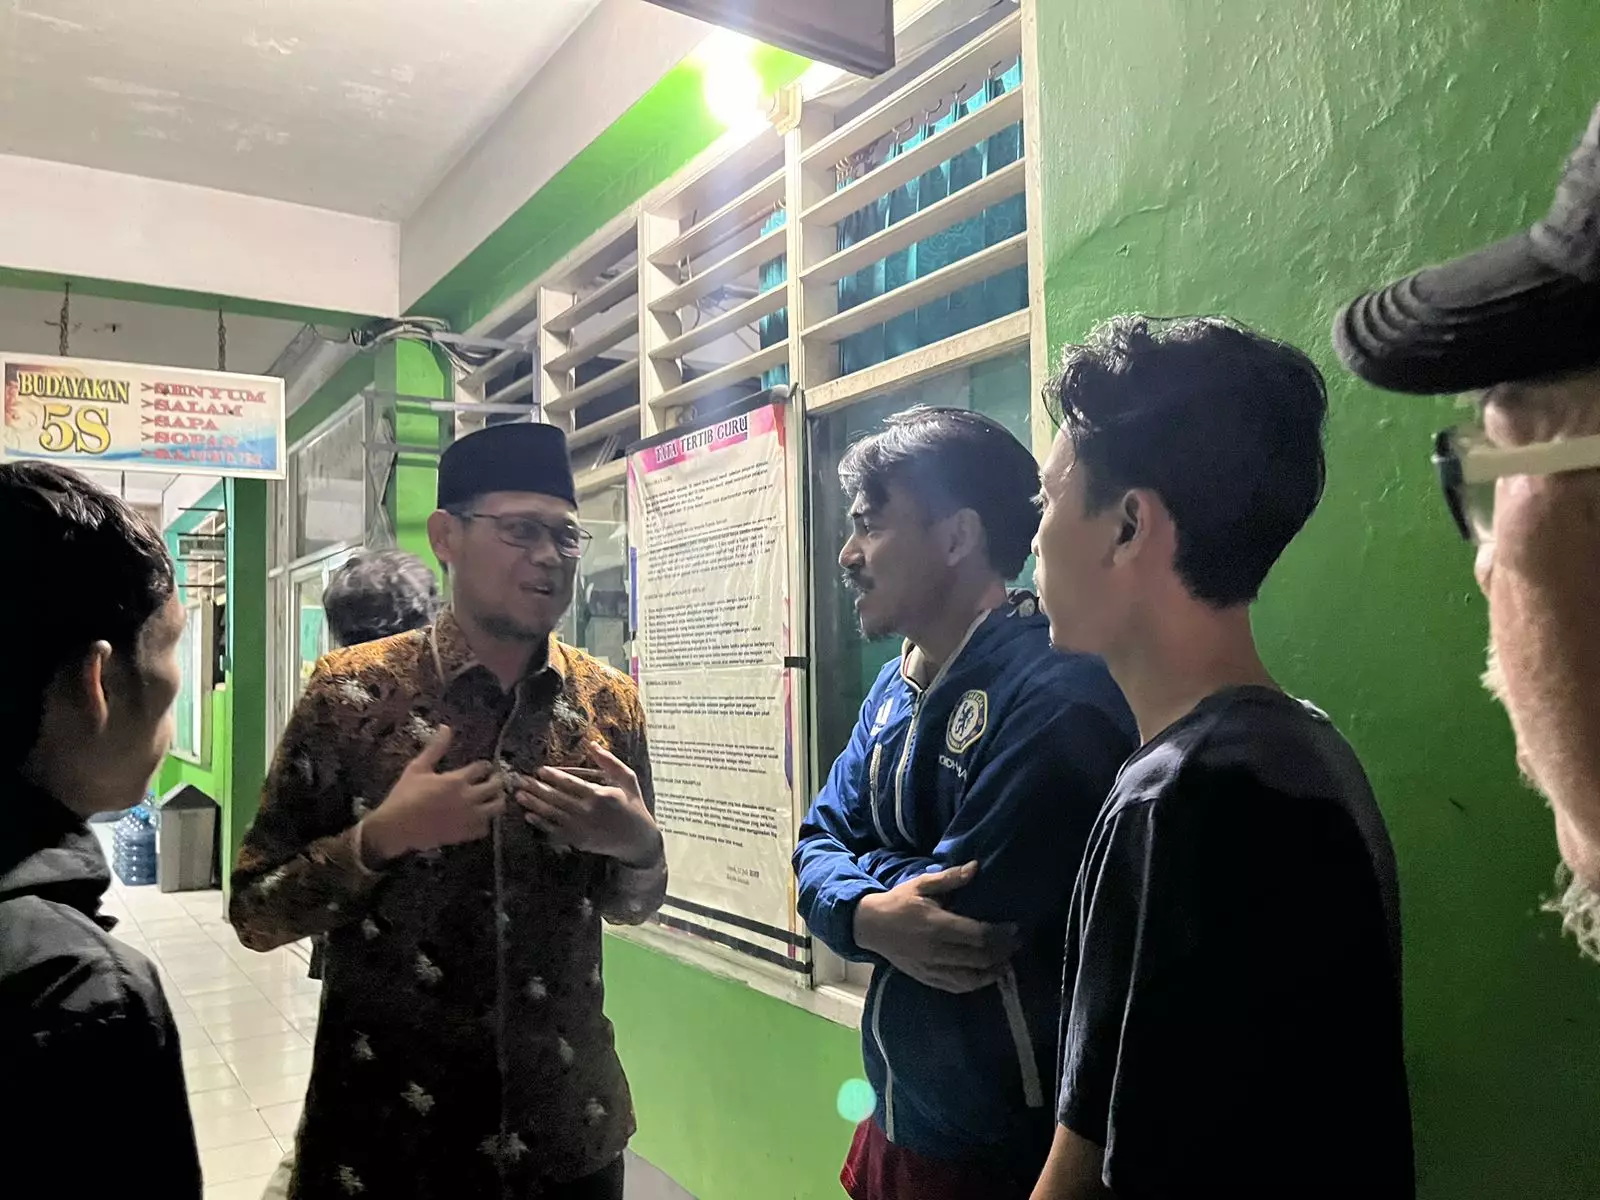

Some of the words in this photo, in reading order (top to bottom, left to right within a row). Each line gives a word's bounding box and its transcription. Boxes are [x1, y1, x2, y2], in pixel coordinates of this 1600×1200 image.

[18, 371, 131, 405] BUDAYAKAN
[153, 381, 267, 404] SENYUM
[153, 398, 243, 418] SALAM
[38, 402, 112, 455] 5S
[153, 414, 220, 432] SAPA
[680, 428, 715, 453] TERTIB
[716, 415, 749, 441] GURU
